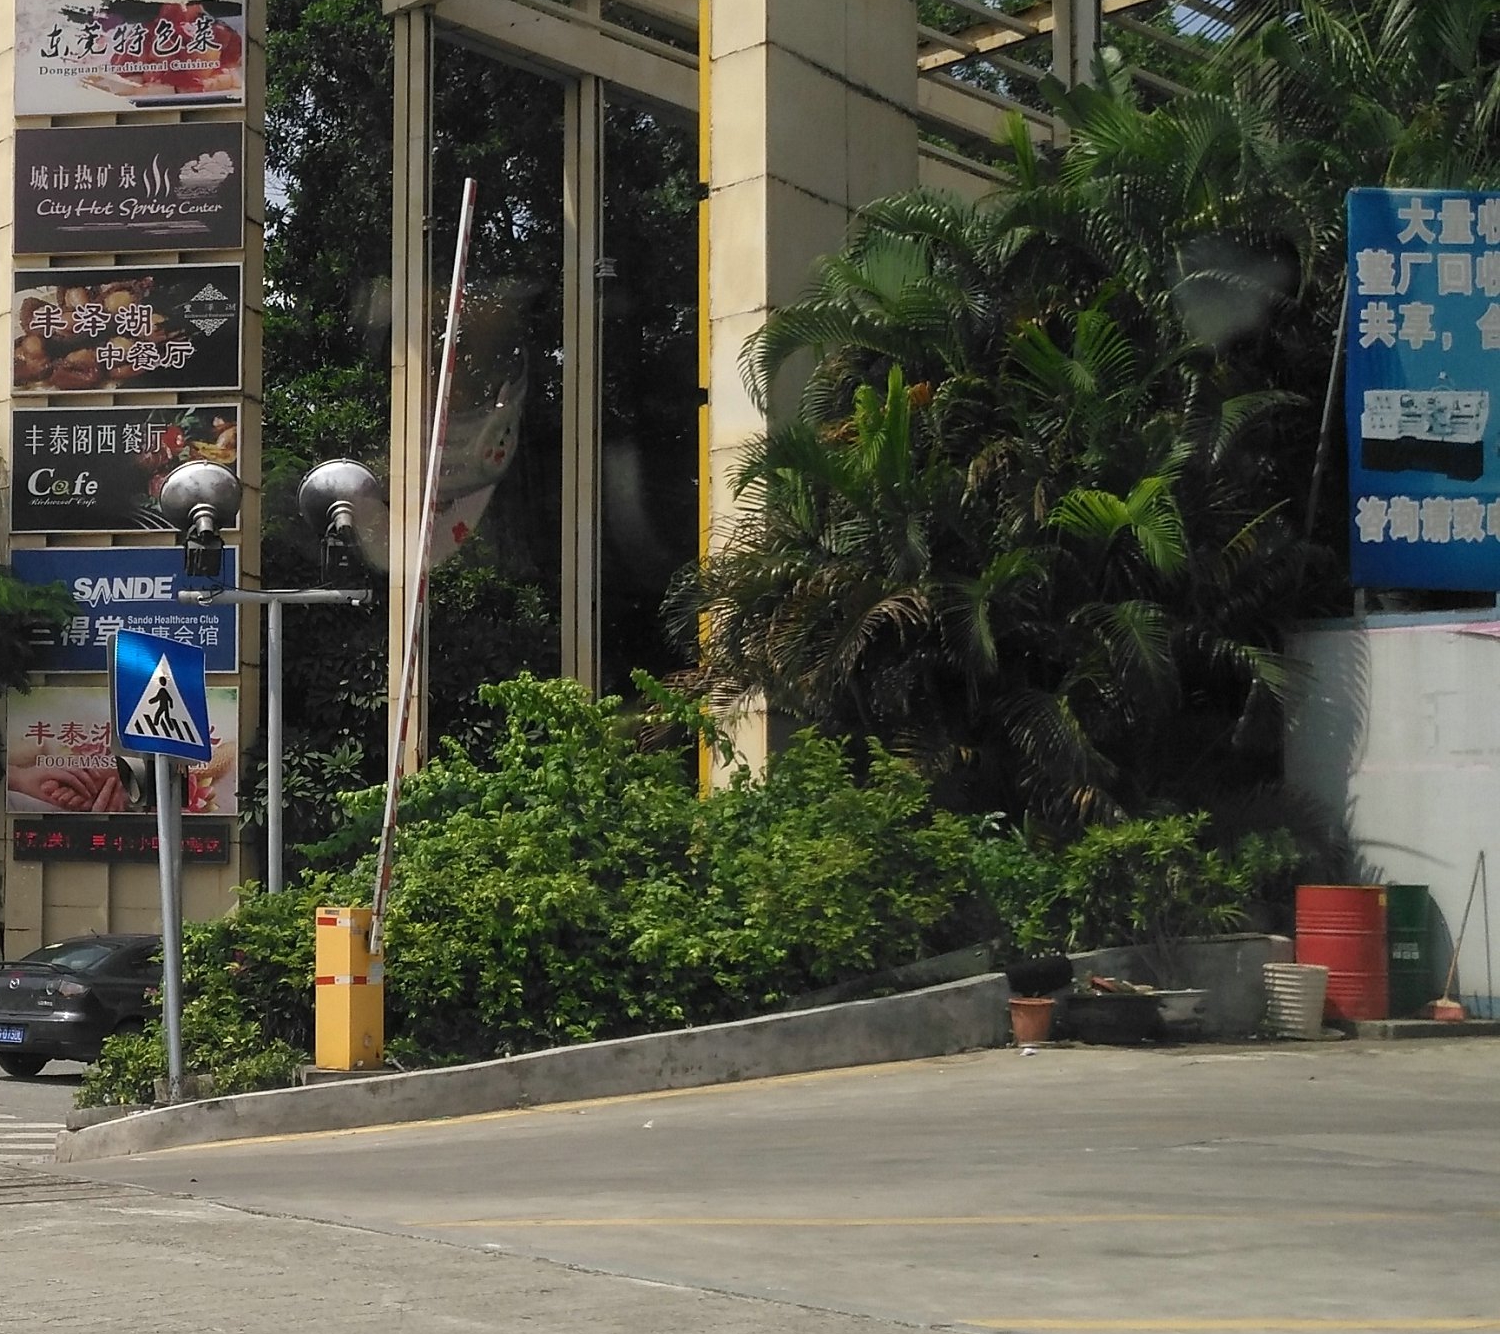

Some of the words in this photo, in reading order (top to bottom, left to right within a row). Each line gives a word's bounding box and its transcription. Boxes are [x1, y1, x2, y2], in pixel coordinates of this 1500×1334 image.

[41, 18, 222, 59] 东莞特色菜
[39, 66, 98, 76] Dongguan
[101, 61, 167, 73] Traditional
[170, 59, 220, 70] Cuisines
[29, 164, 137, 190] 城市热矿泉
[36, 199, 72, 219] City
[74, 199, 114, 215] Hot
[119, 198, 176, 219] Spring
[178, 201, 222, 213] Center
[30, 303, 155, 338] 丰泽湖
[96, 341, 195, 371] 中餐厅
[24, 423, 168, 455] 丰泰阁西餐厅
[27, 468, 98, 496] Cafe
[73, 577, 175, 601] SANDE
[154, 616, 198, 624] Healthcare
[199, 616, 219, 624] Club
